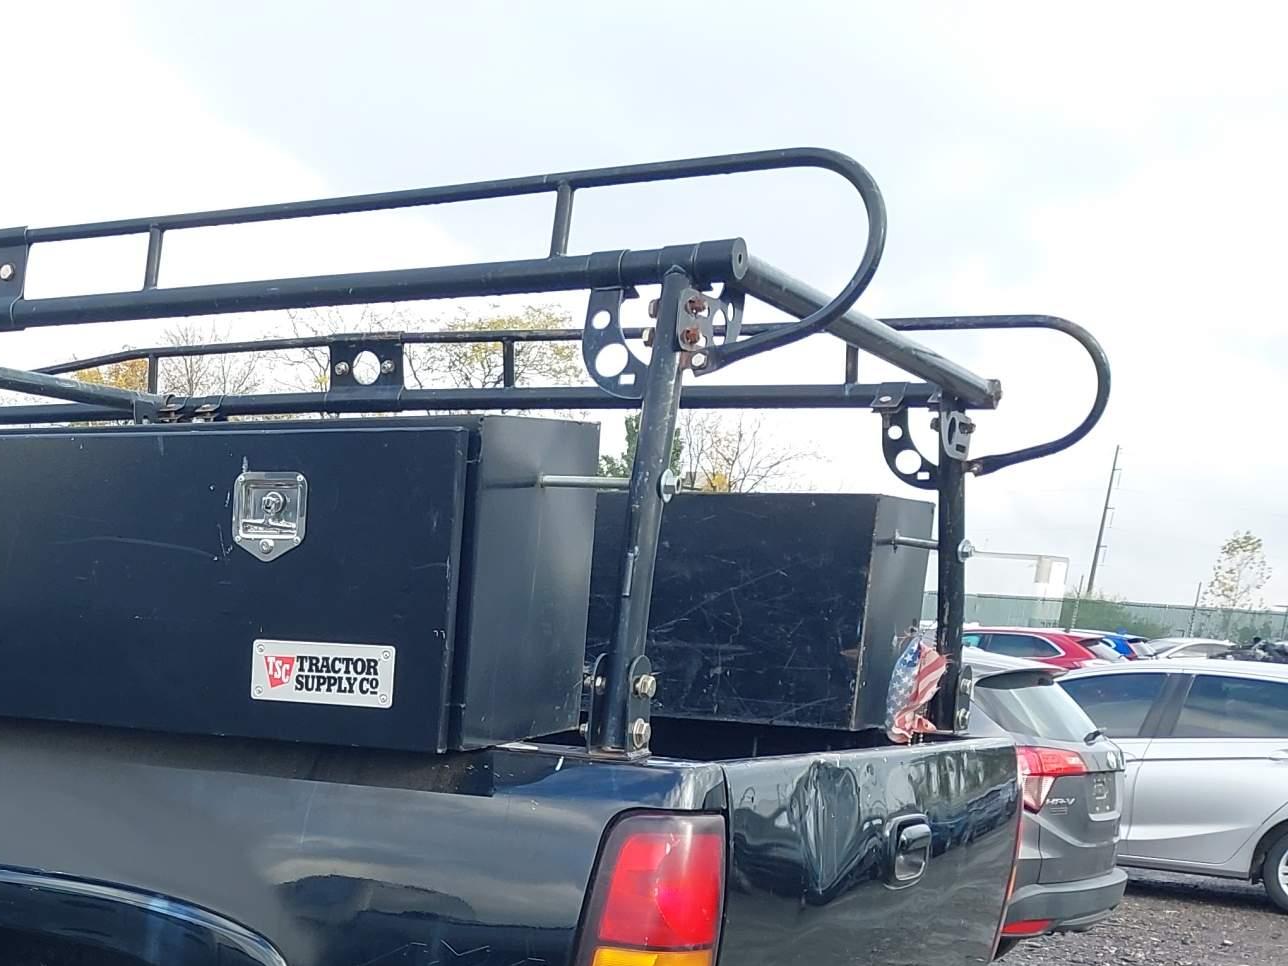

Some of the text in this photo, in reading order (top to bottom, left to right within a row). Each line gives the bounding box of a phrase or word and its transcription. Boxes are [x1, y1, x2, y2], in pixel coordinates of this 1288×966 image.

[267, 656, 290, 683] TSC
[296, 655, 379, 676] TRACTOR
[294, 674, 358, 694] SUPPLY
